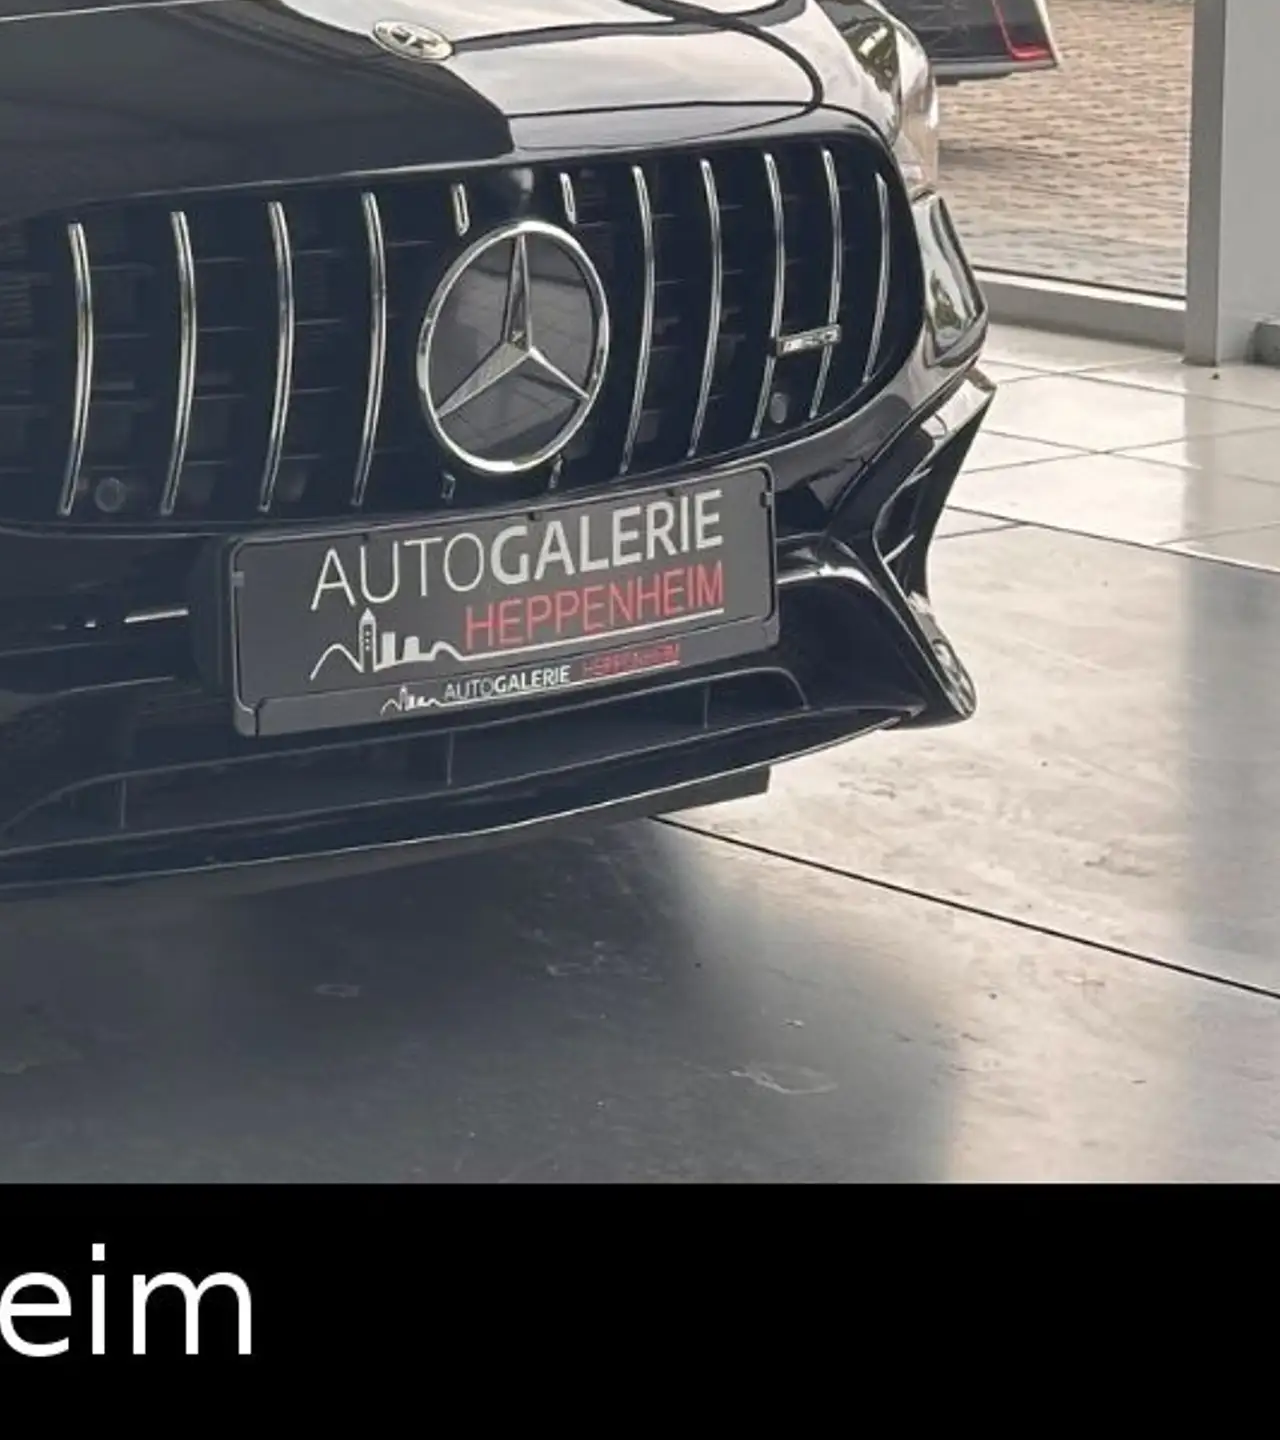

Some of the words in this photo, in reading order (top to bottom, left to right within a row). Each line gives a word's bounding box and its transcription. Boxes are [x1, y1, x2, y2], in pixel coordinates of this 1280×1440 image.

[310, 488, 724, 612] AUTOGALERIE
[465, 560, 724, 651] HEPPENHEIM
[443, 664, 571, 702] AUTOGALERIE
